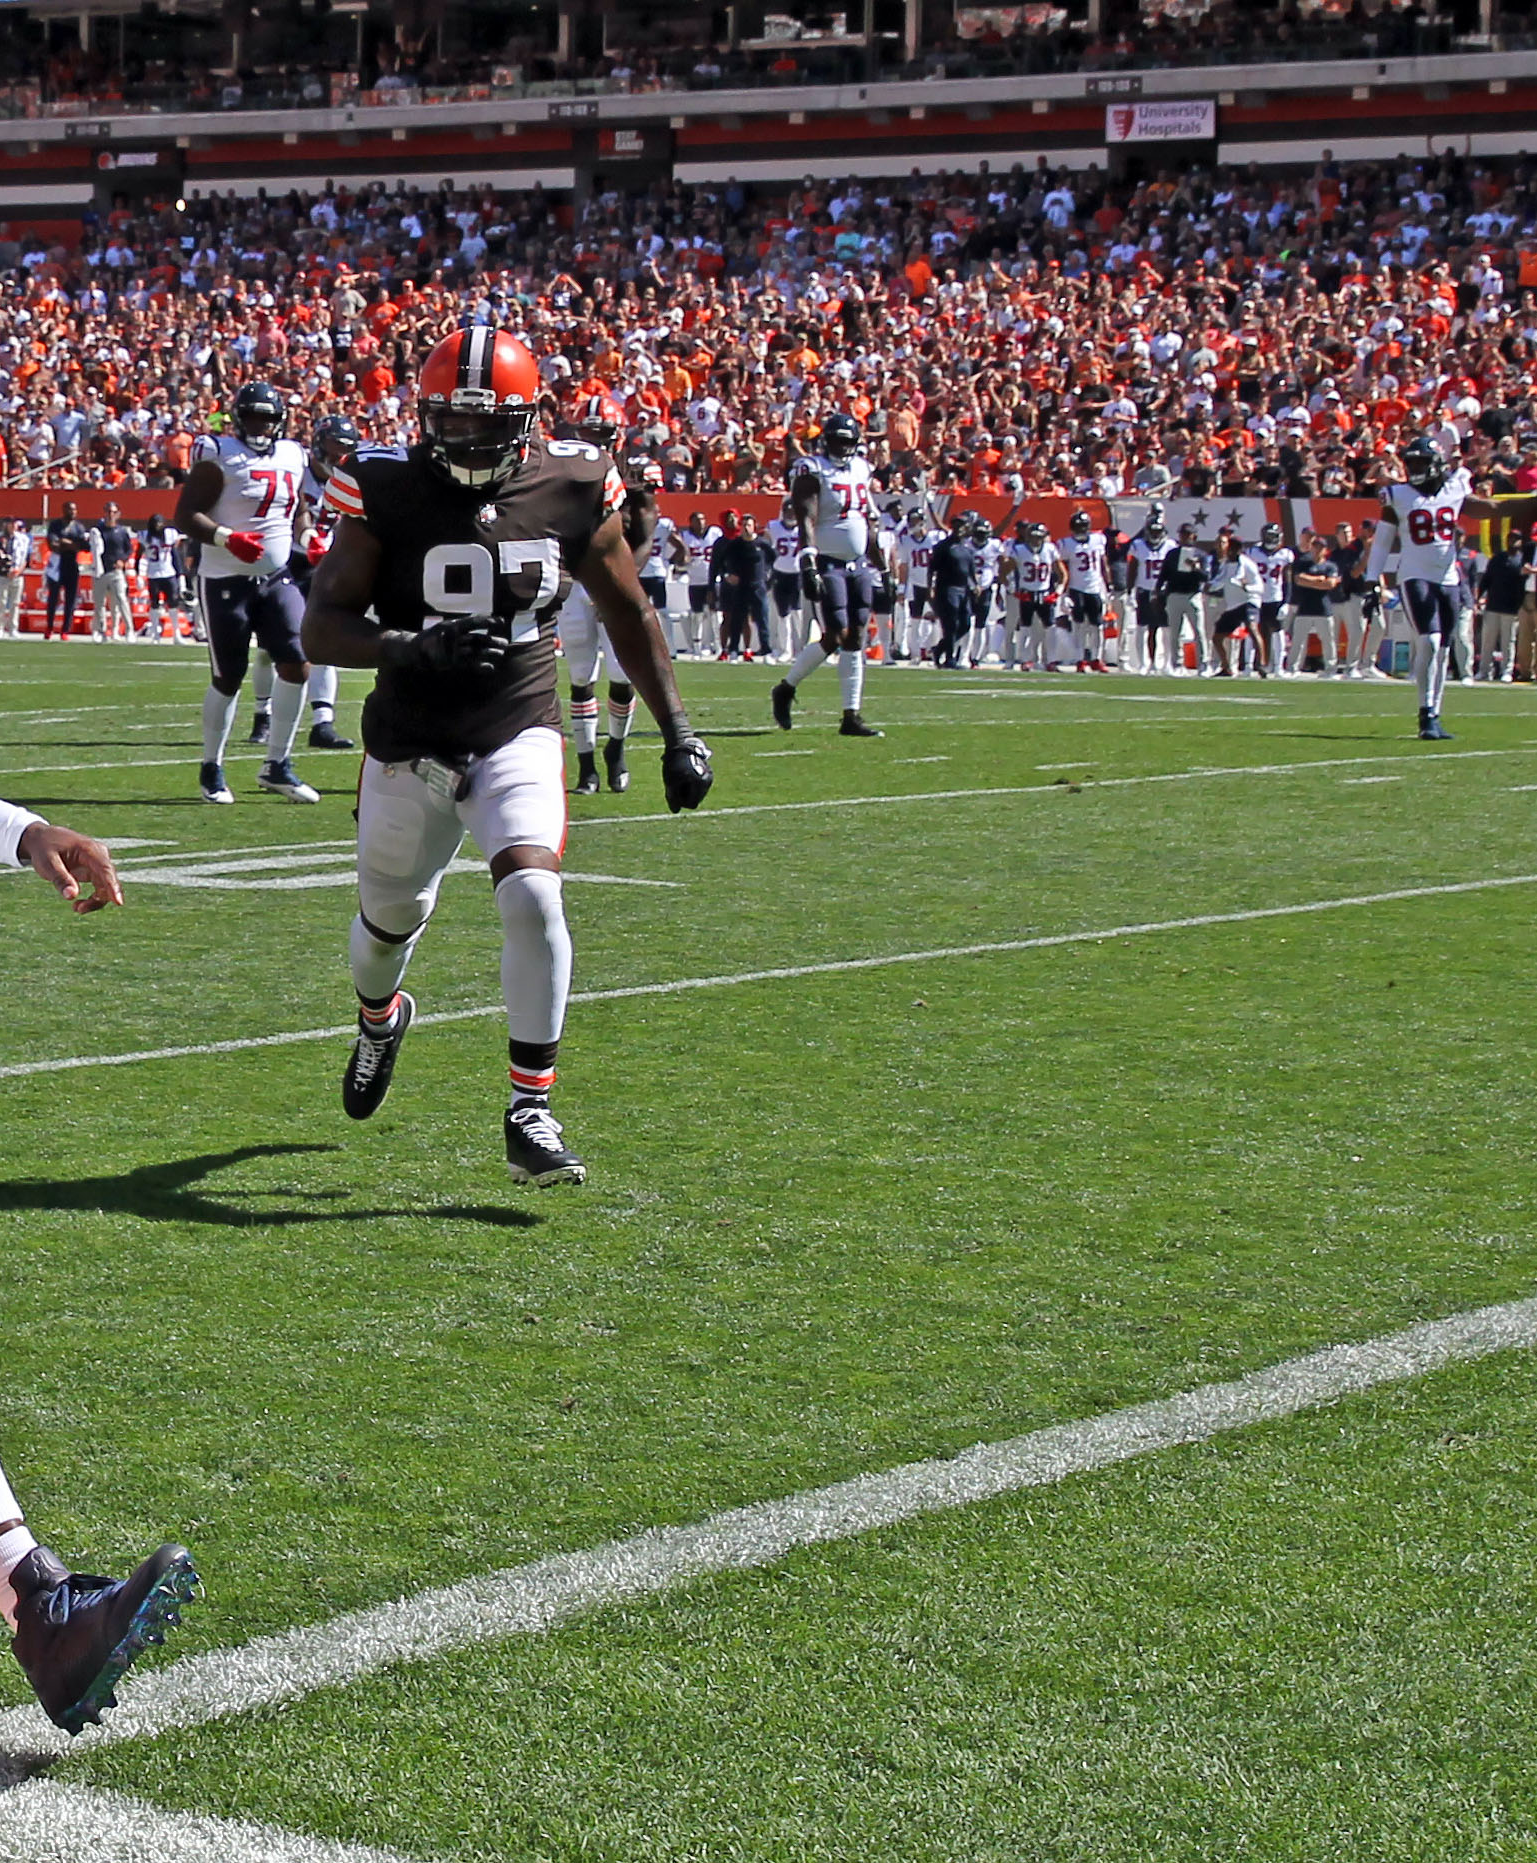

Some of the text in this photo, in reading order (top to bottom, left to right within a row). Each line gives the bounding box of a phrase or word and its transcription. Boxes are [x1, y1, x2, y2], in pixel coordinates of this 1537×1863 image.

[1138, 106, 1209, 120] University
[1138, 122, 1202, 137] Hospitals
[249, 470, 296, 519] 71
[1408, 507, 1455, 546] 88
[148, 545, 172, 562] 37
[1075, 550, 1098, 571] 31
[1023, 562, 1049, 582] 30
[423, 537, 561, 643] 97
